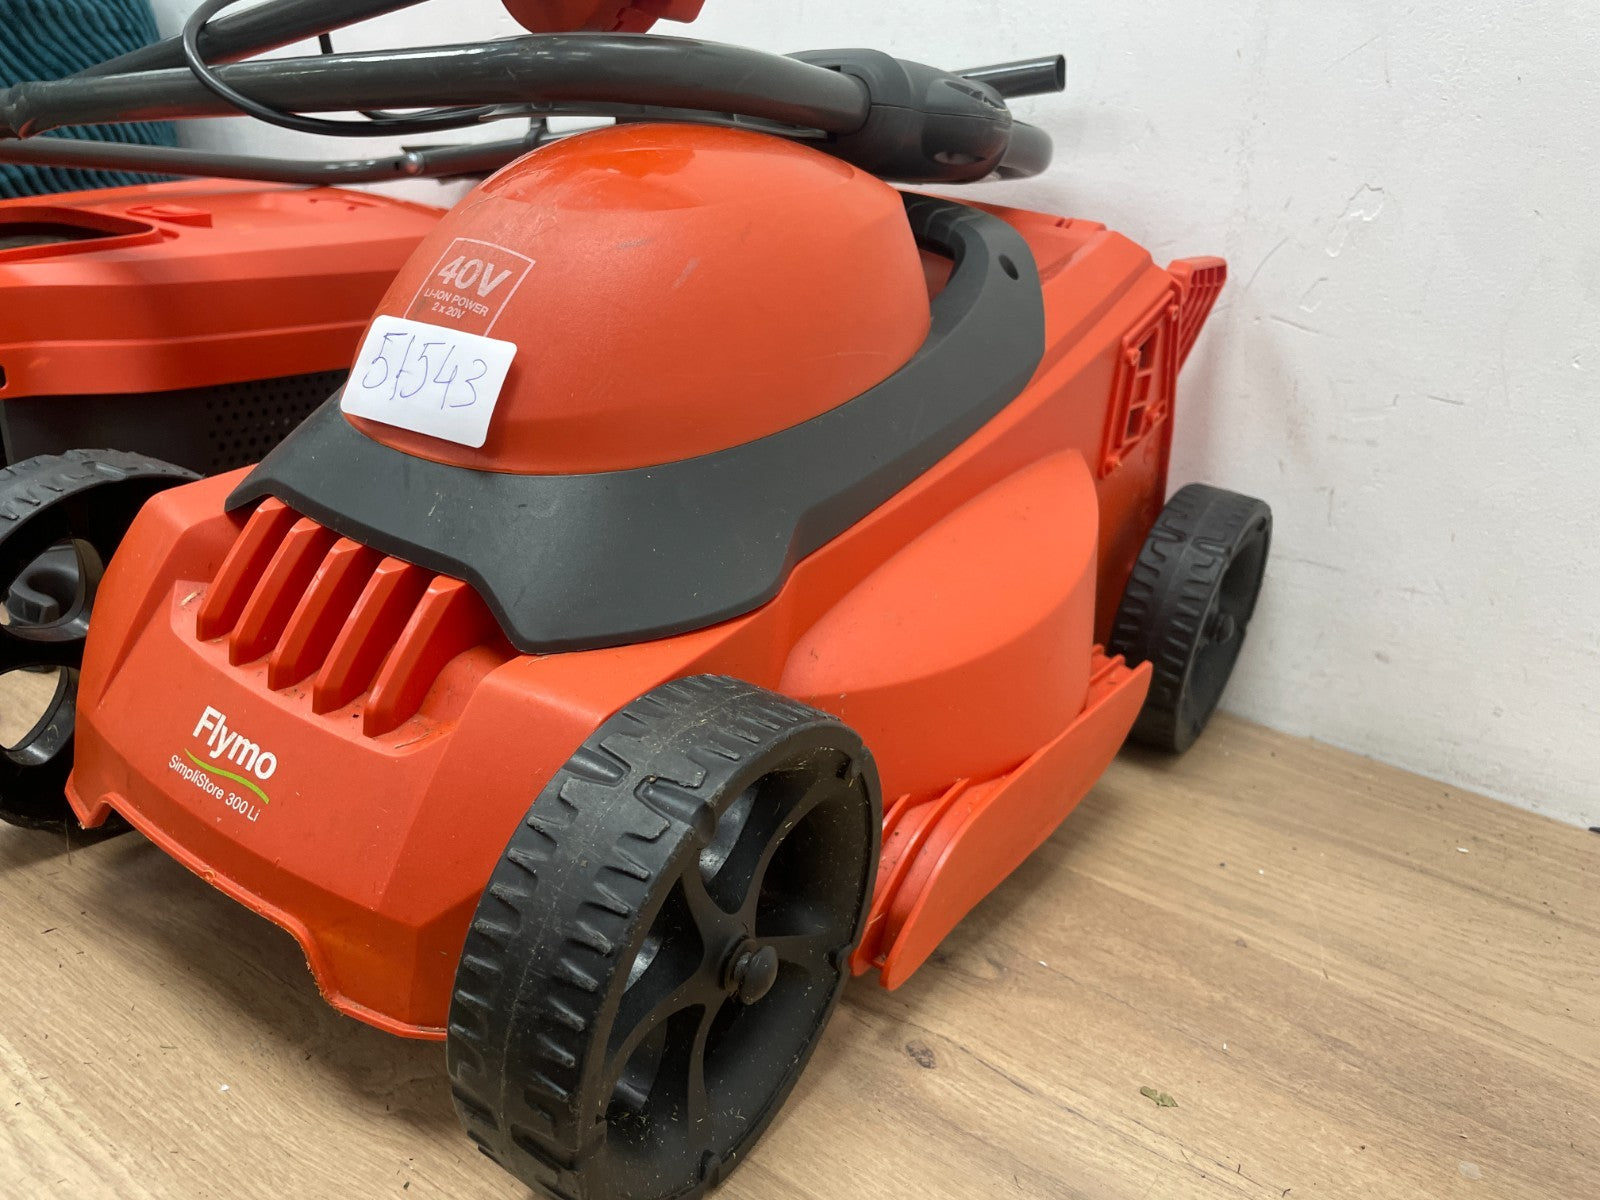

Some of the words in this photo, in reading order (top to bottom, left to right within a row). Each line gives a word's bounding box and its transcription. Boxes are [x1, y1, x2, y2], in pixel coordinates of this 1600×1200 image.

[438, 255, 512, 297] 40V
[424, 288, 452, 302] LI-ION
[451, 294, 489, 317] POWER
[432, 302, 439, 311] 2
[445, 306, 466, 319] 20V
[192, 705, 277, 780] Flymo
[168, 755, 224, 800] SimpliStore
[225, 792, 249, 814] 300
[247, 805, 261, 822] Li
